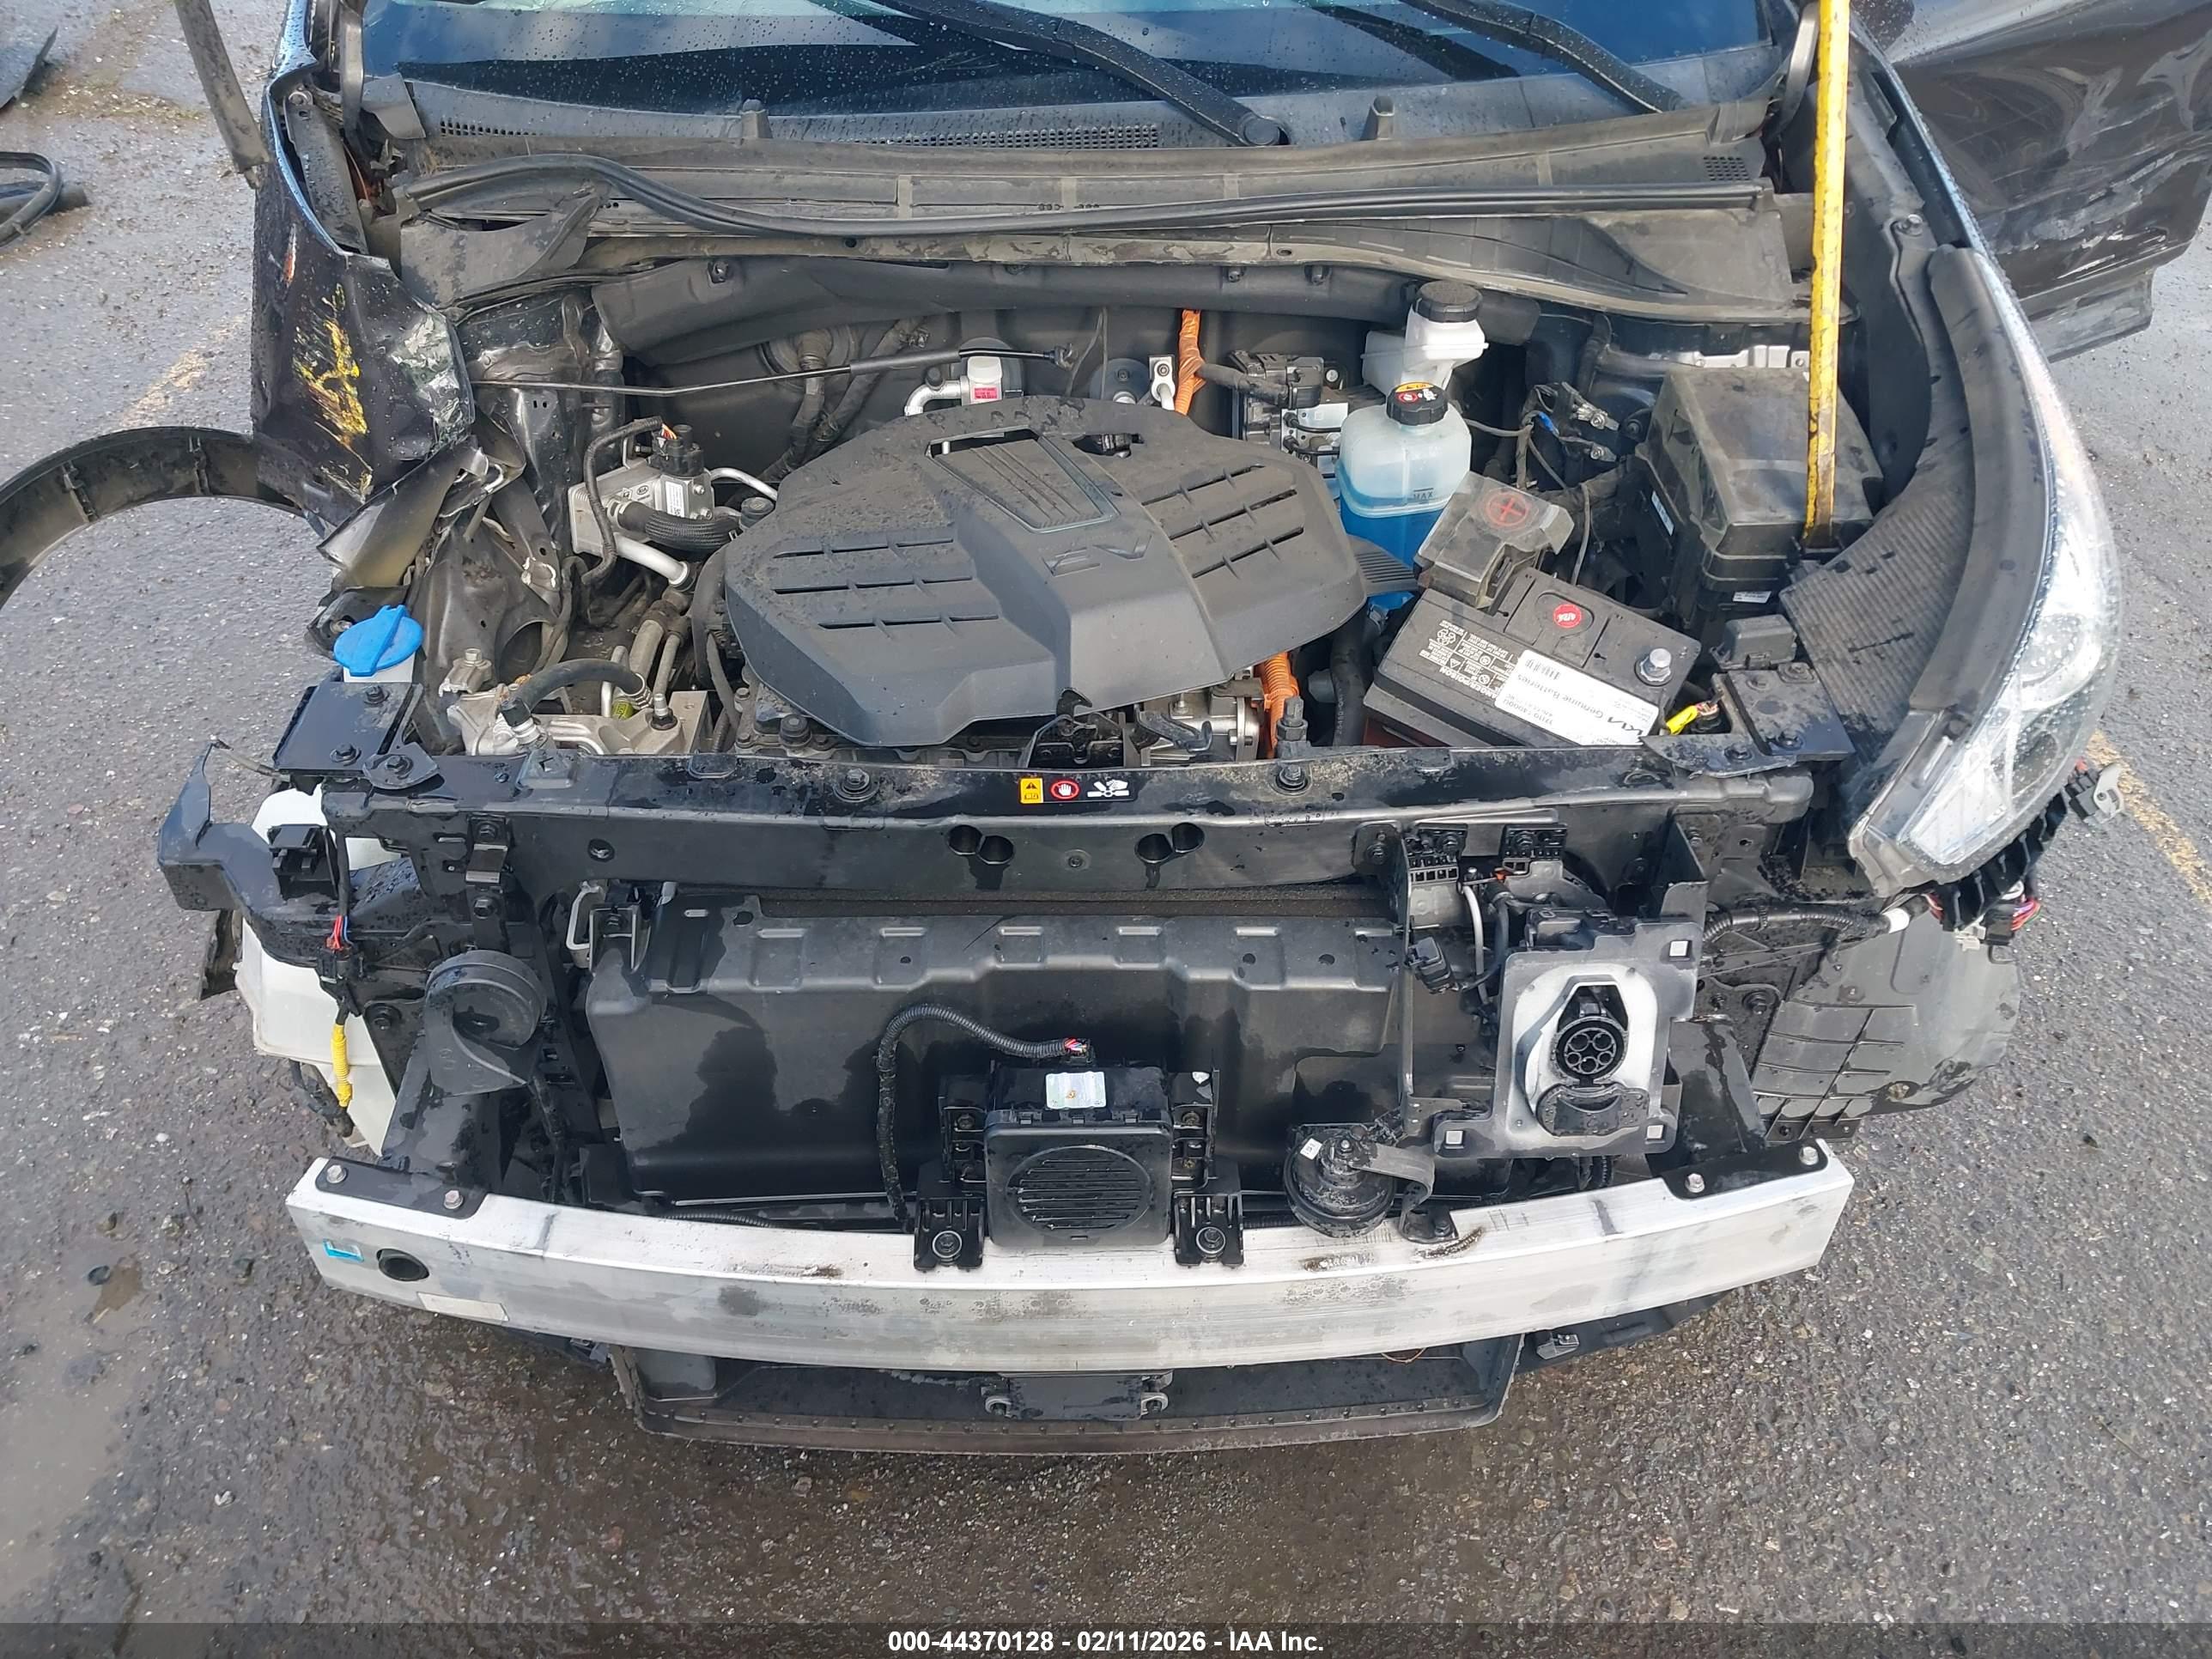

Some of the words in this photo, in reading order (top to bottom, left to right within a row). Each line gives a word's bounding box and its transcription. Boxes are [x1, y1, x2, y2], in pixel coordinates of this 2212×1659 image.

[1413, 491, 1433, 501] MAX
[1517, 673, 1560, 702] Batteries
[1562, 696, 1604, 719] Genuine
